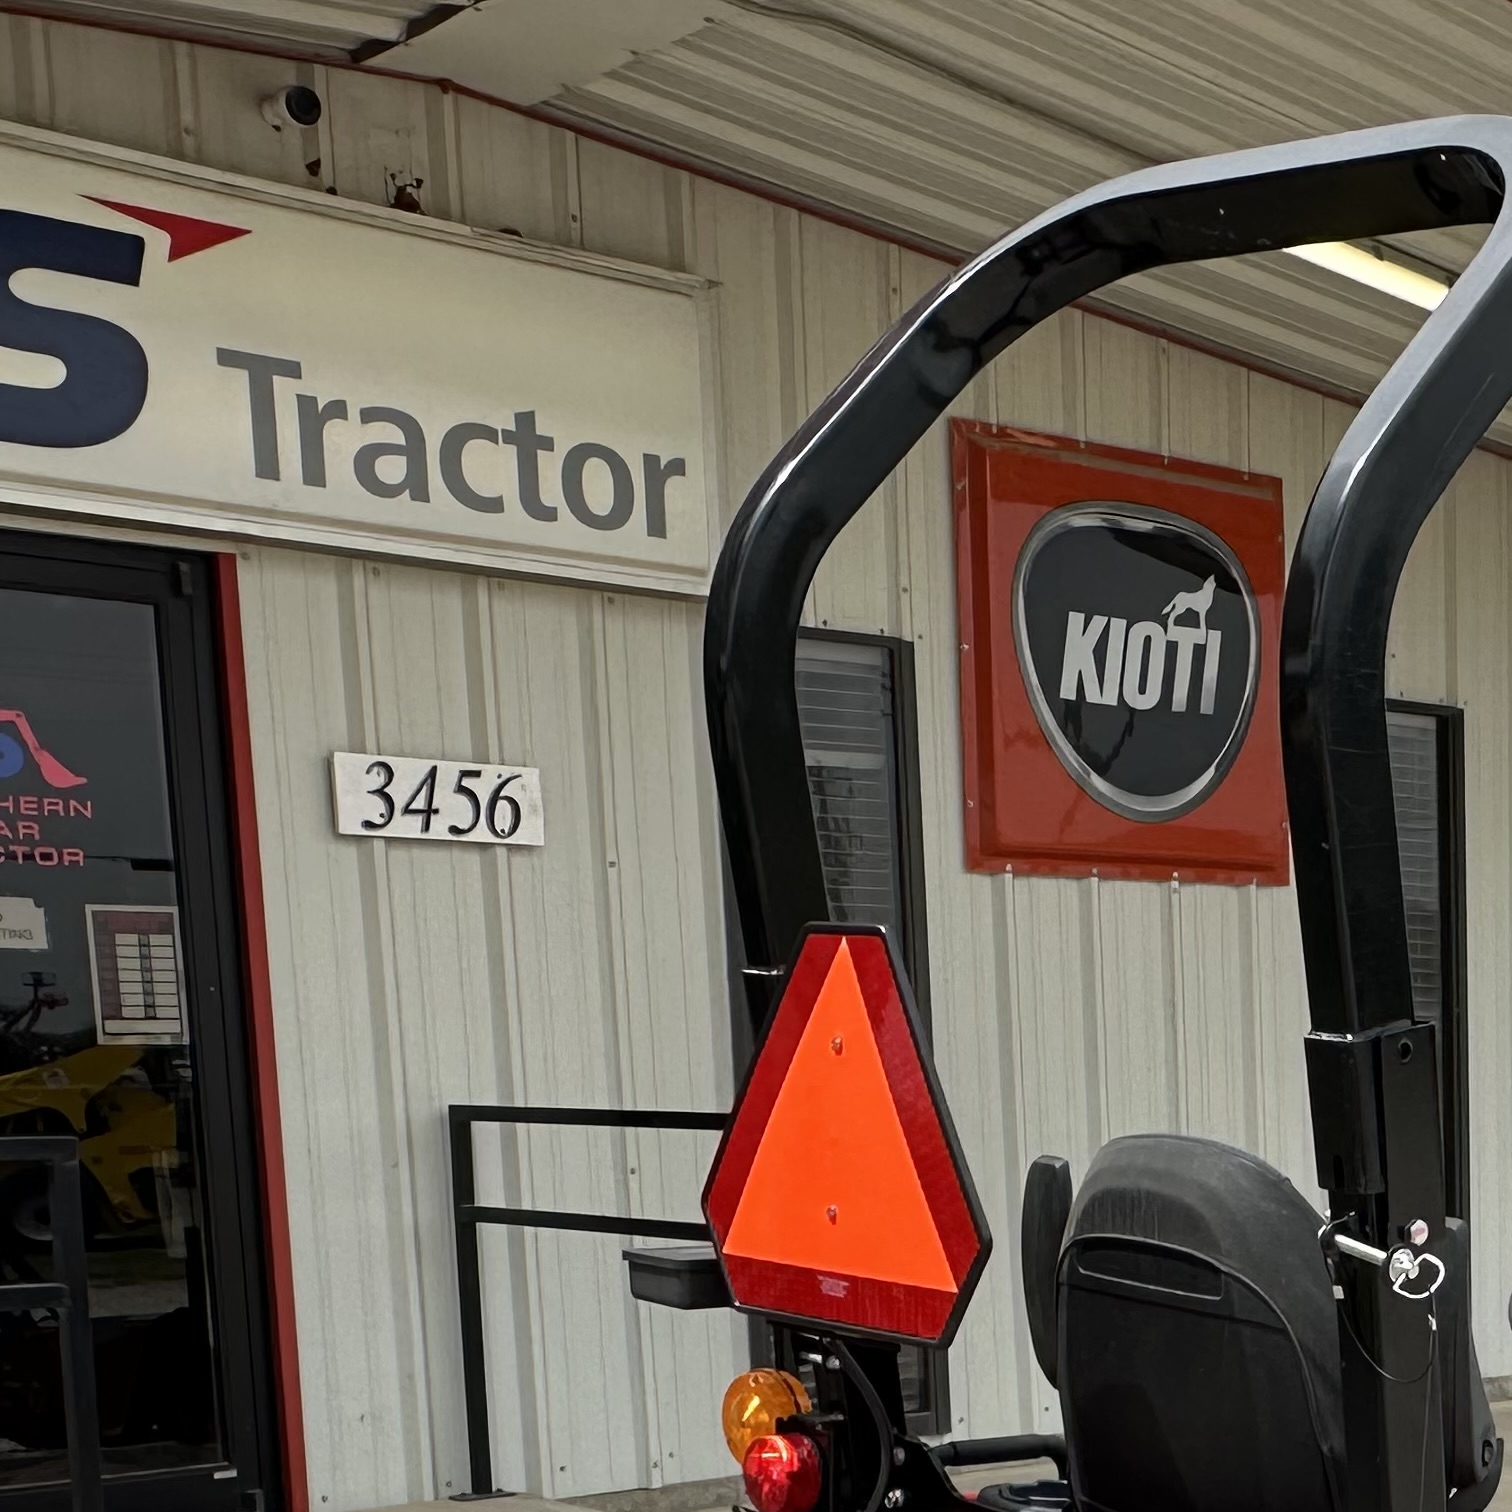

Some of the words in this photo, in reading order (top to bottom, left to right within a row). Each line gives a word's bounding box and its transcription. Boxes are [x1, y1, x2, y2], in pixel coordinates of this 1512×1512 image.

[216, 347, 687, 540] Tractor
[1060, 610, 1223, 715] KIOTI
[361, 760, 524, 840] 3456
